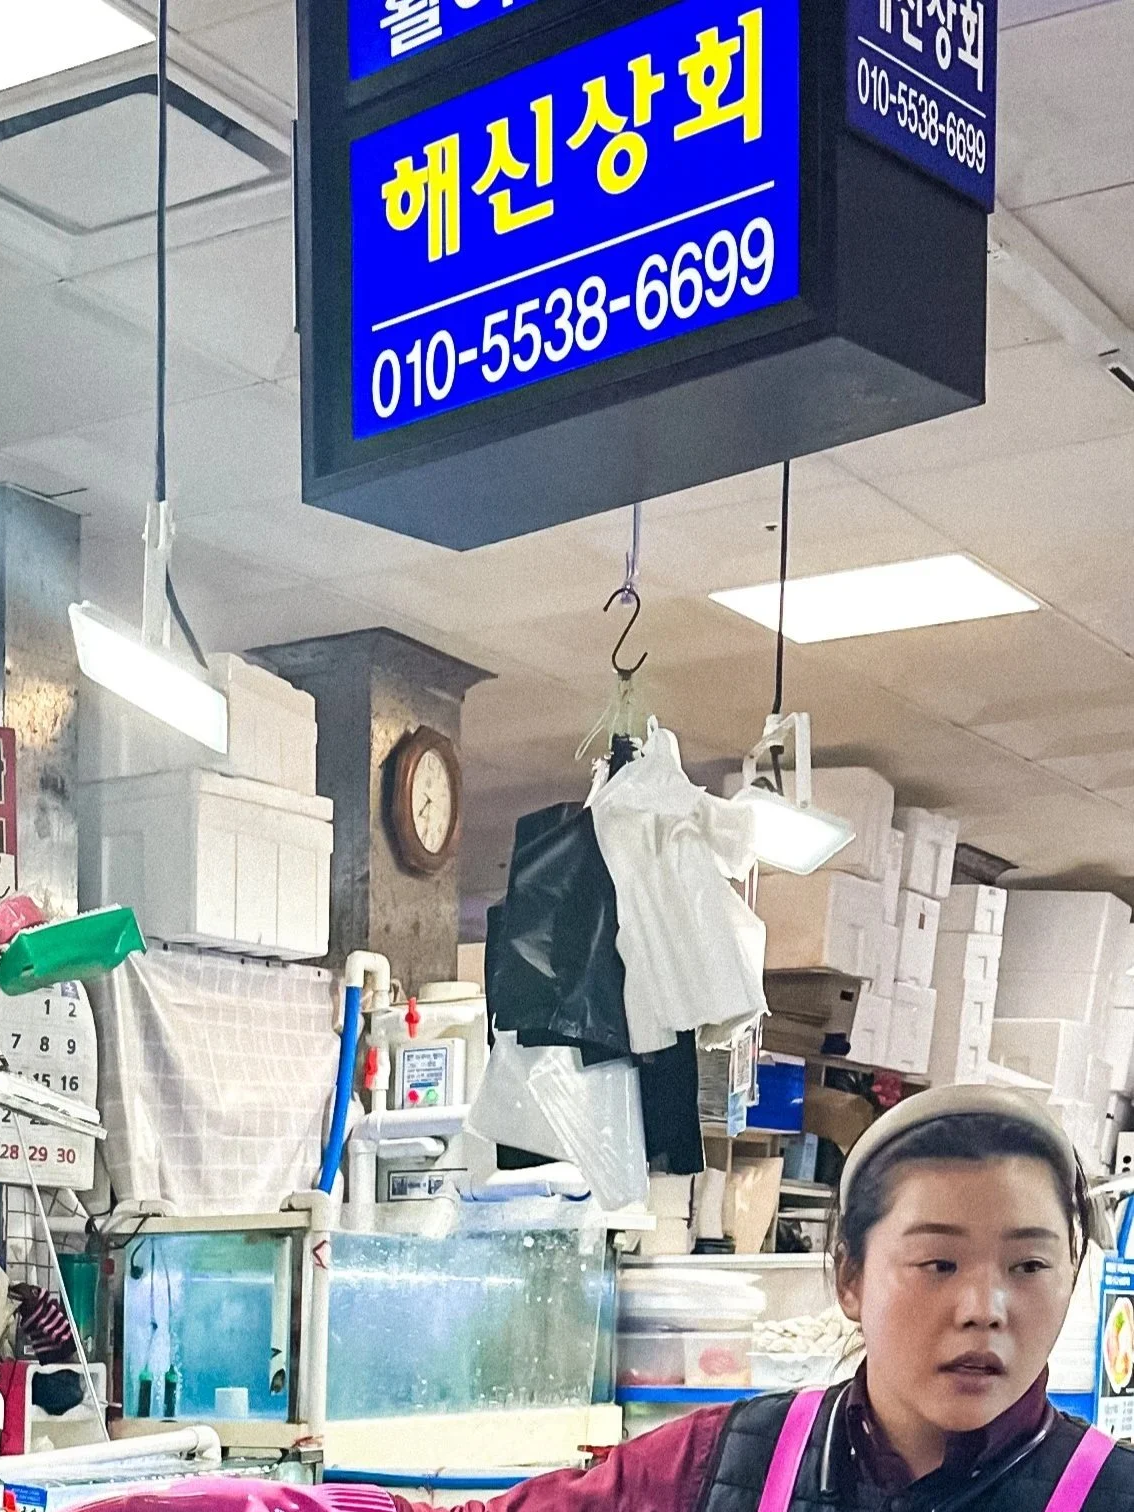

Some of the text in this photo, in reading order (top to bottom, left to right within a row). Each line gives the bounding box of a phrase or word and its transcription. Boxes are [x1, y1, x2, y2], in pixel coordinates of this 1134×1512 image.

[857, 57, 986, 175] 010-5538-6699
[379, 7, 766, 264] 해신상회
[371, 216, 775, 420] 010-5538-6699
[44, 999, 77, 1018] 1 2
[11, 1033, 21, 1049] 7
[39, 1036, 50, 1052] 8
[67, 1038, 76, 1055] 9
[33, 1073, 79, 1091] 15 16
[0, 1144, 19, 1160] 28
[28, 1146, 48, 1162] 29
[56, 1148, 76, 1164] 30
